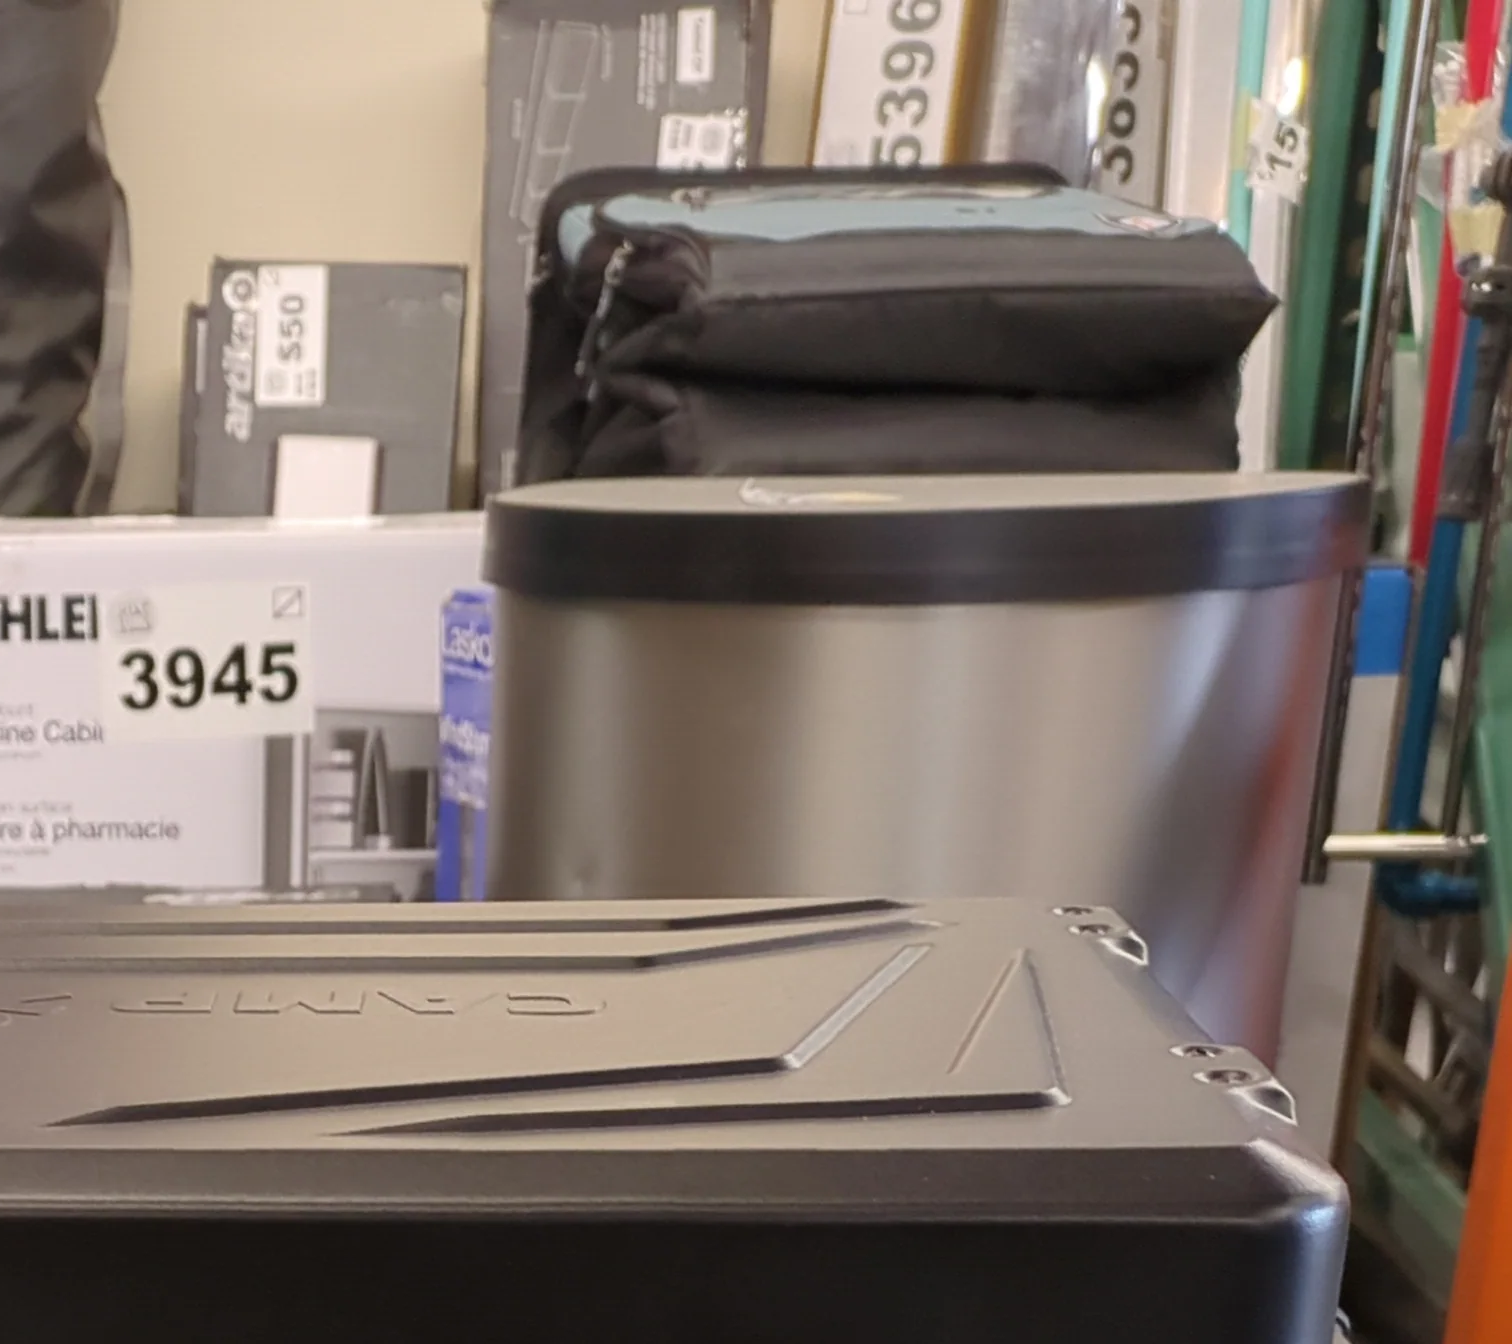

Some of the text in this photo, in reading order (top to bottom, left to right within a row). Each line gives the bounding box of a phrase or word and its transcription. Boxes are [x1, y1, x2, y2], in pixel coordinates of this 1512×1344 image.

[119, 642, 300, 710] 3945
[29, 817, 45, 840] à
[52, 818, 180, 843] pharmacie
